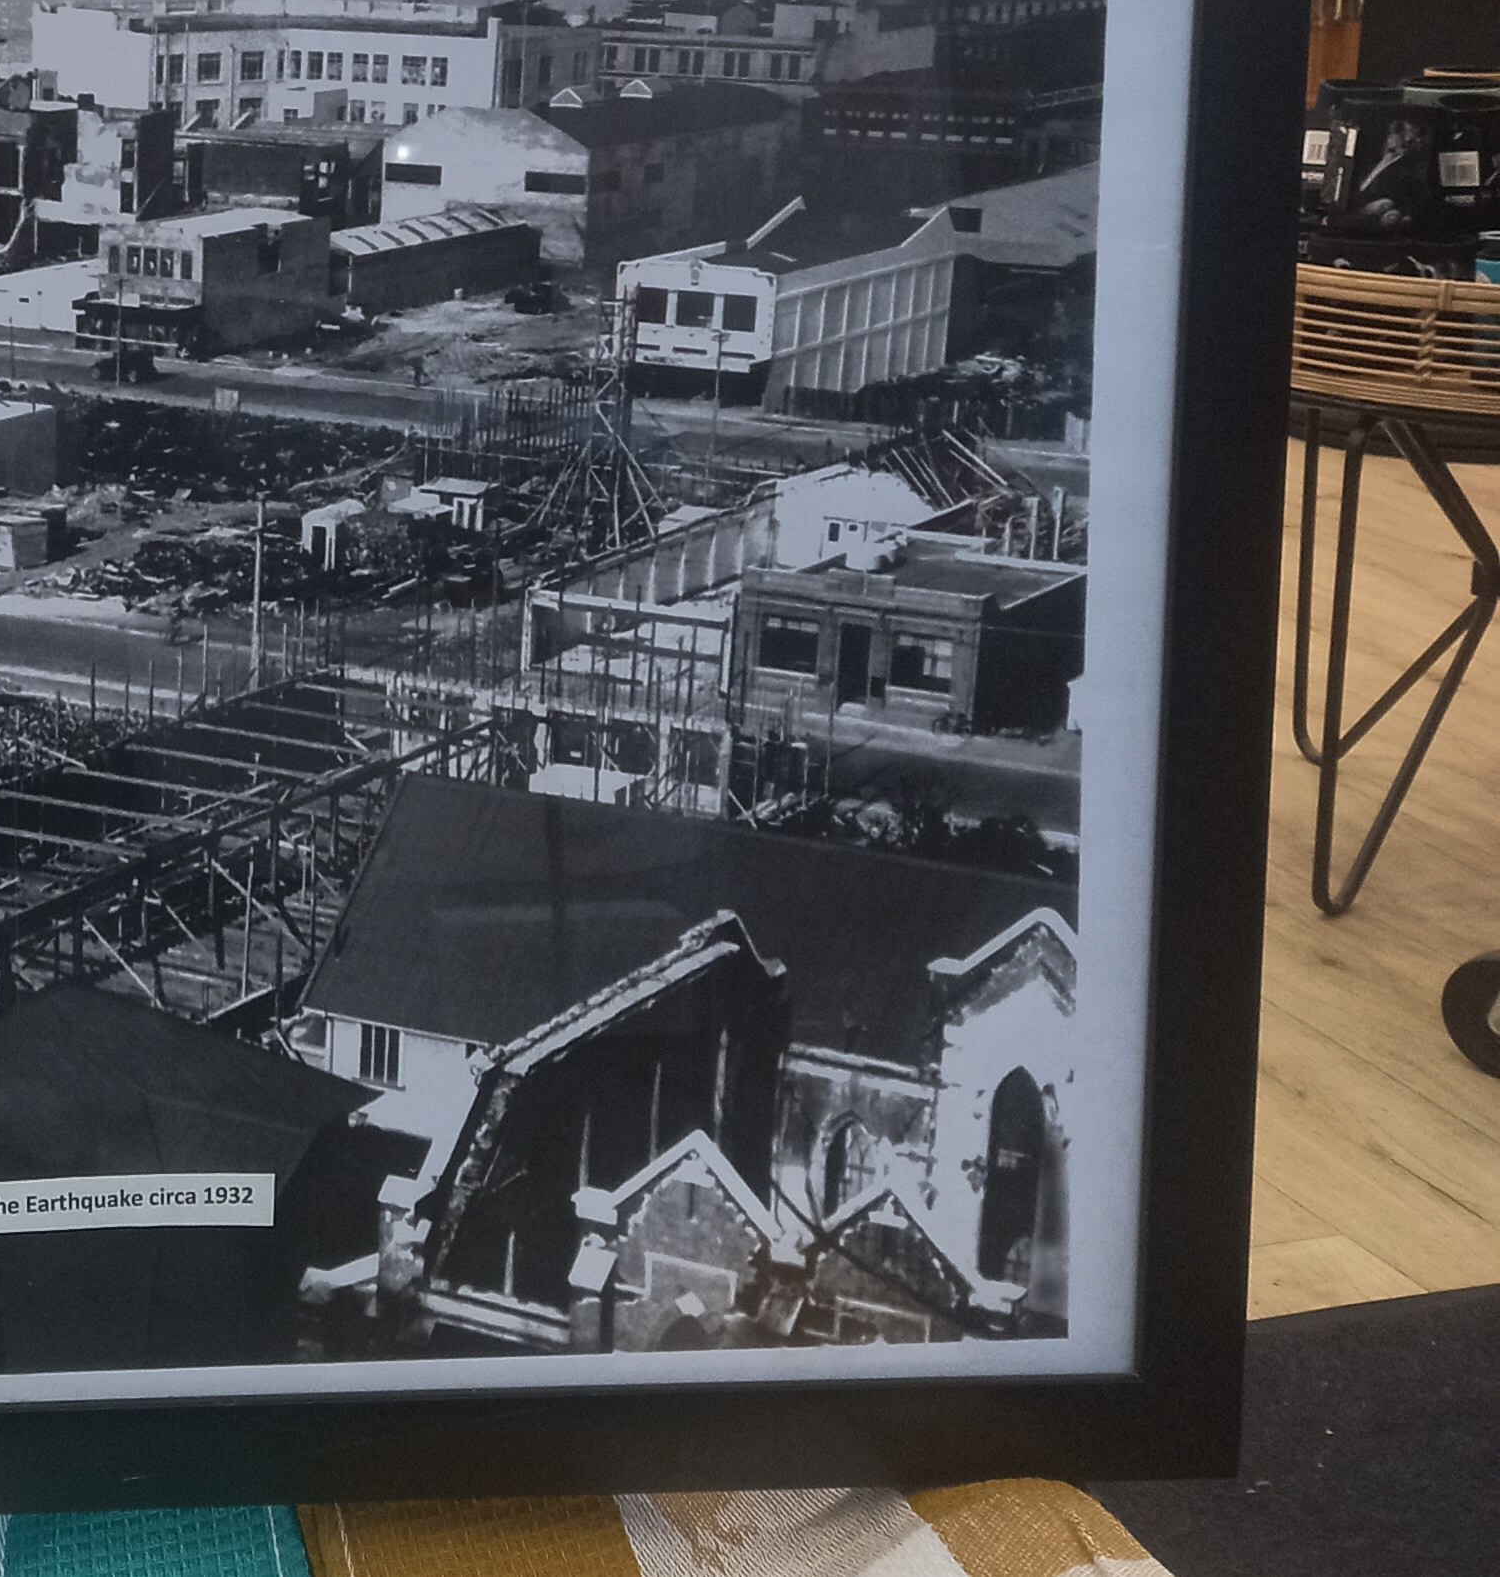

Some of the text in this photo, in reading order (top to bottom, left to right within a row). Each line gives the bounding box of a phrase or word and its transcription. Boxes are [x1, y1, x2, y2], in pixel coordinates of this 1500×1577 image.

[25, 1188, 144, 1214] Earthquake
[149, 1191, 197, 1206] circa
[203, 1186, 254, 1205] 1932
